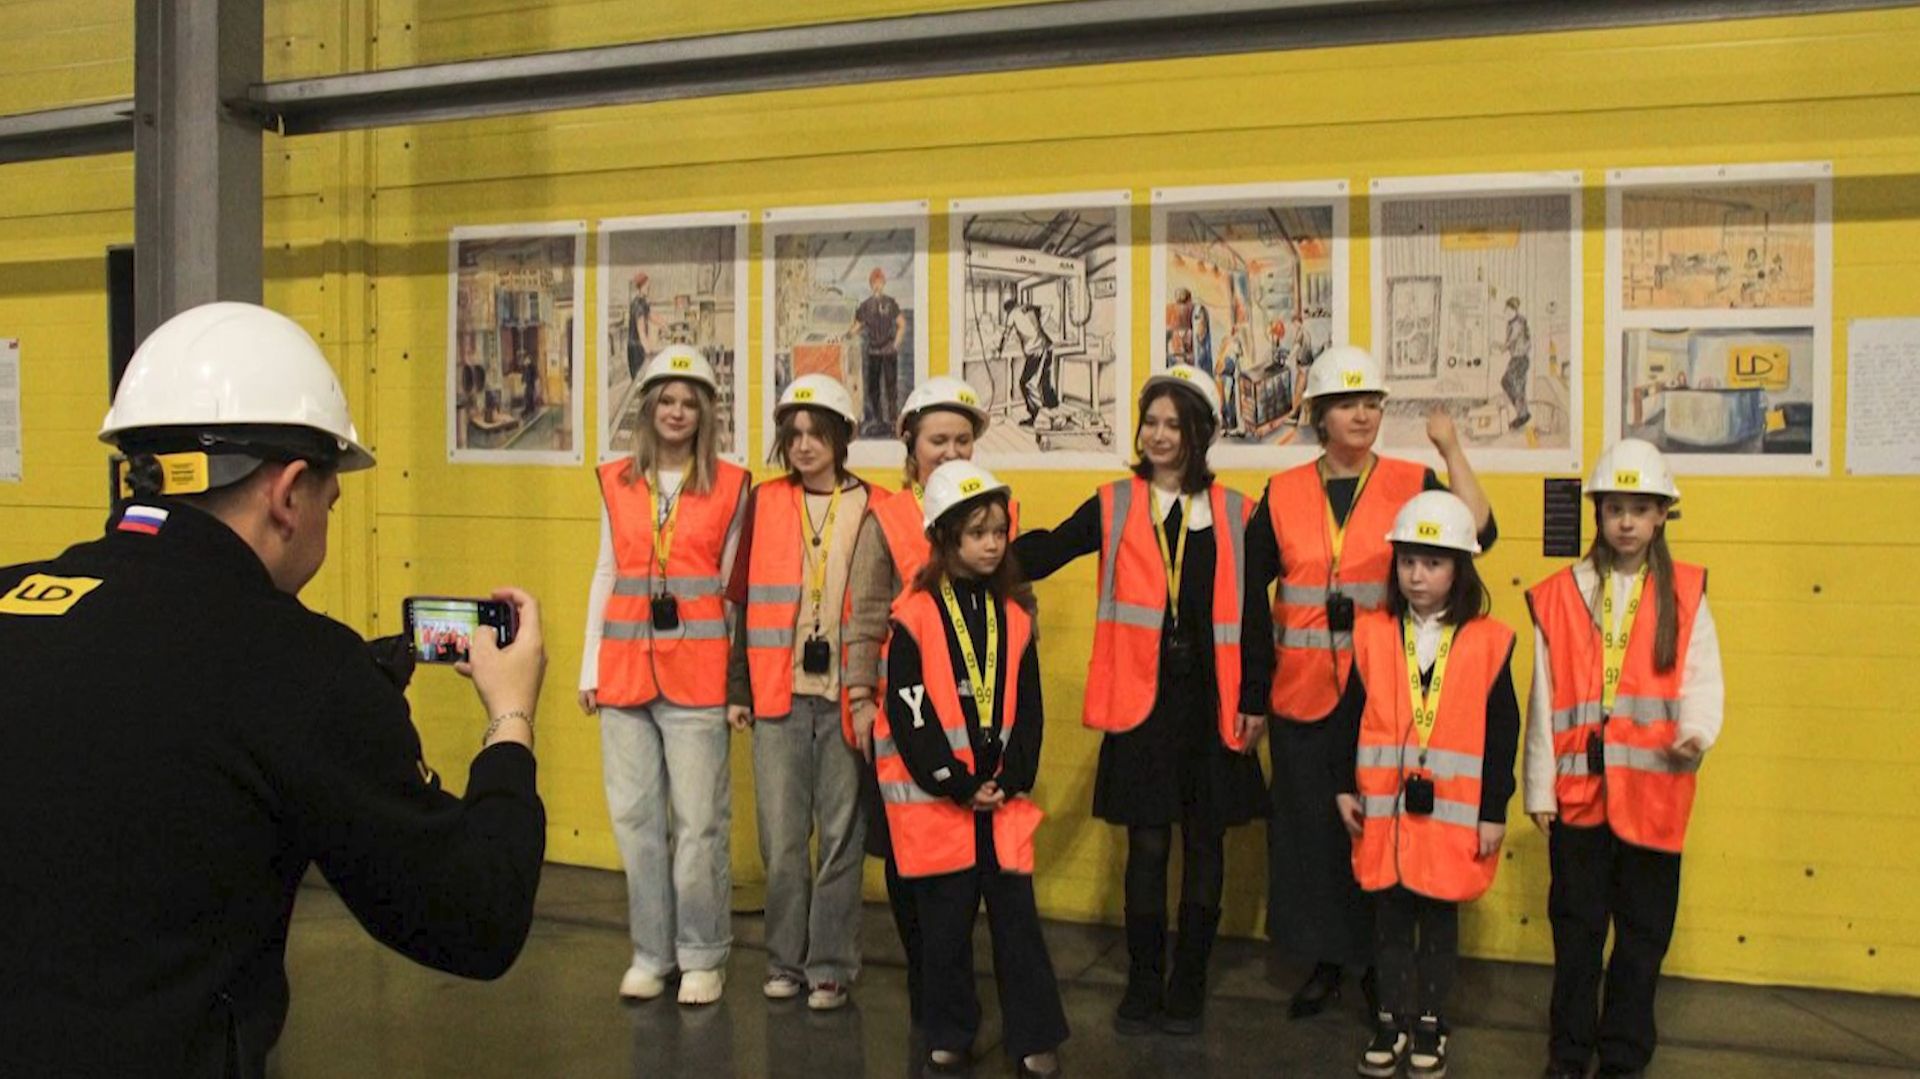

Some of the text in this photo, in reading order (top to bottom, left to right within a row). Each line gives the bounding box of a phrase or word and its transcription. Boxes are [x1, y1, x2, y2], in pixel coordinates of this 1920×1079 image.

[1736, 354, 1774, 376] LD
[16, 582, 74, 602] LD
[898, 683, 925, 729] Y
